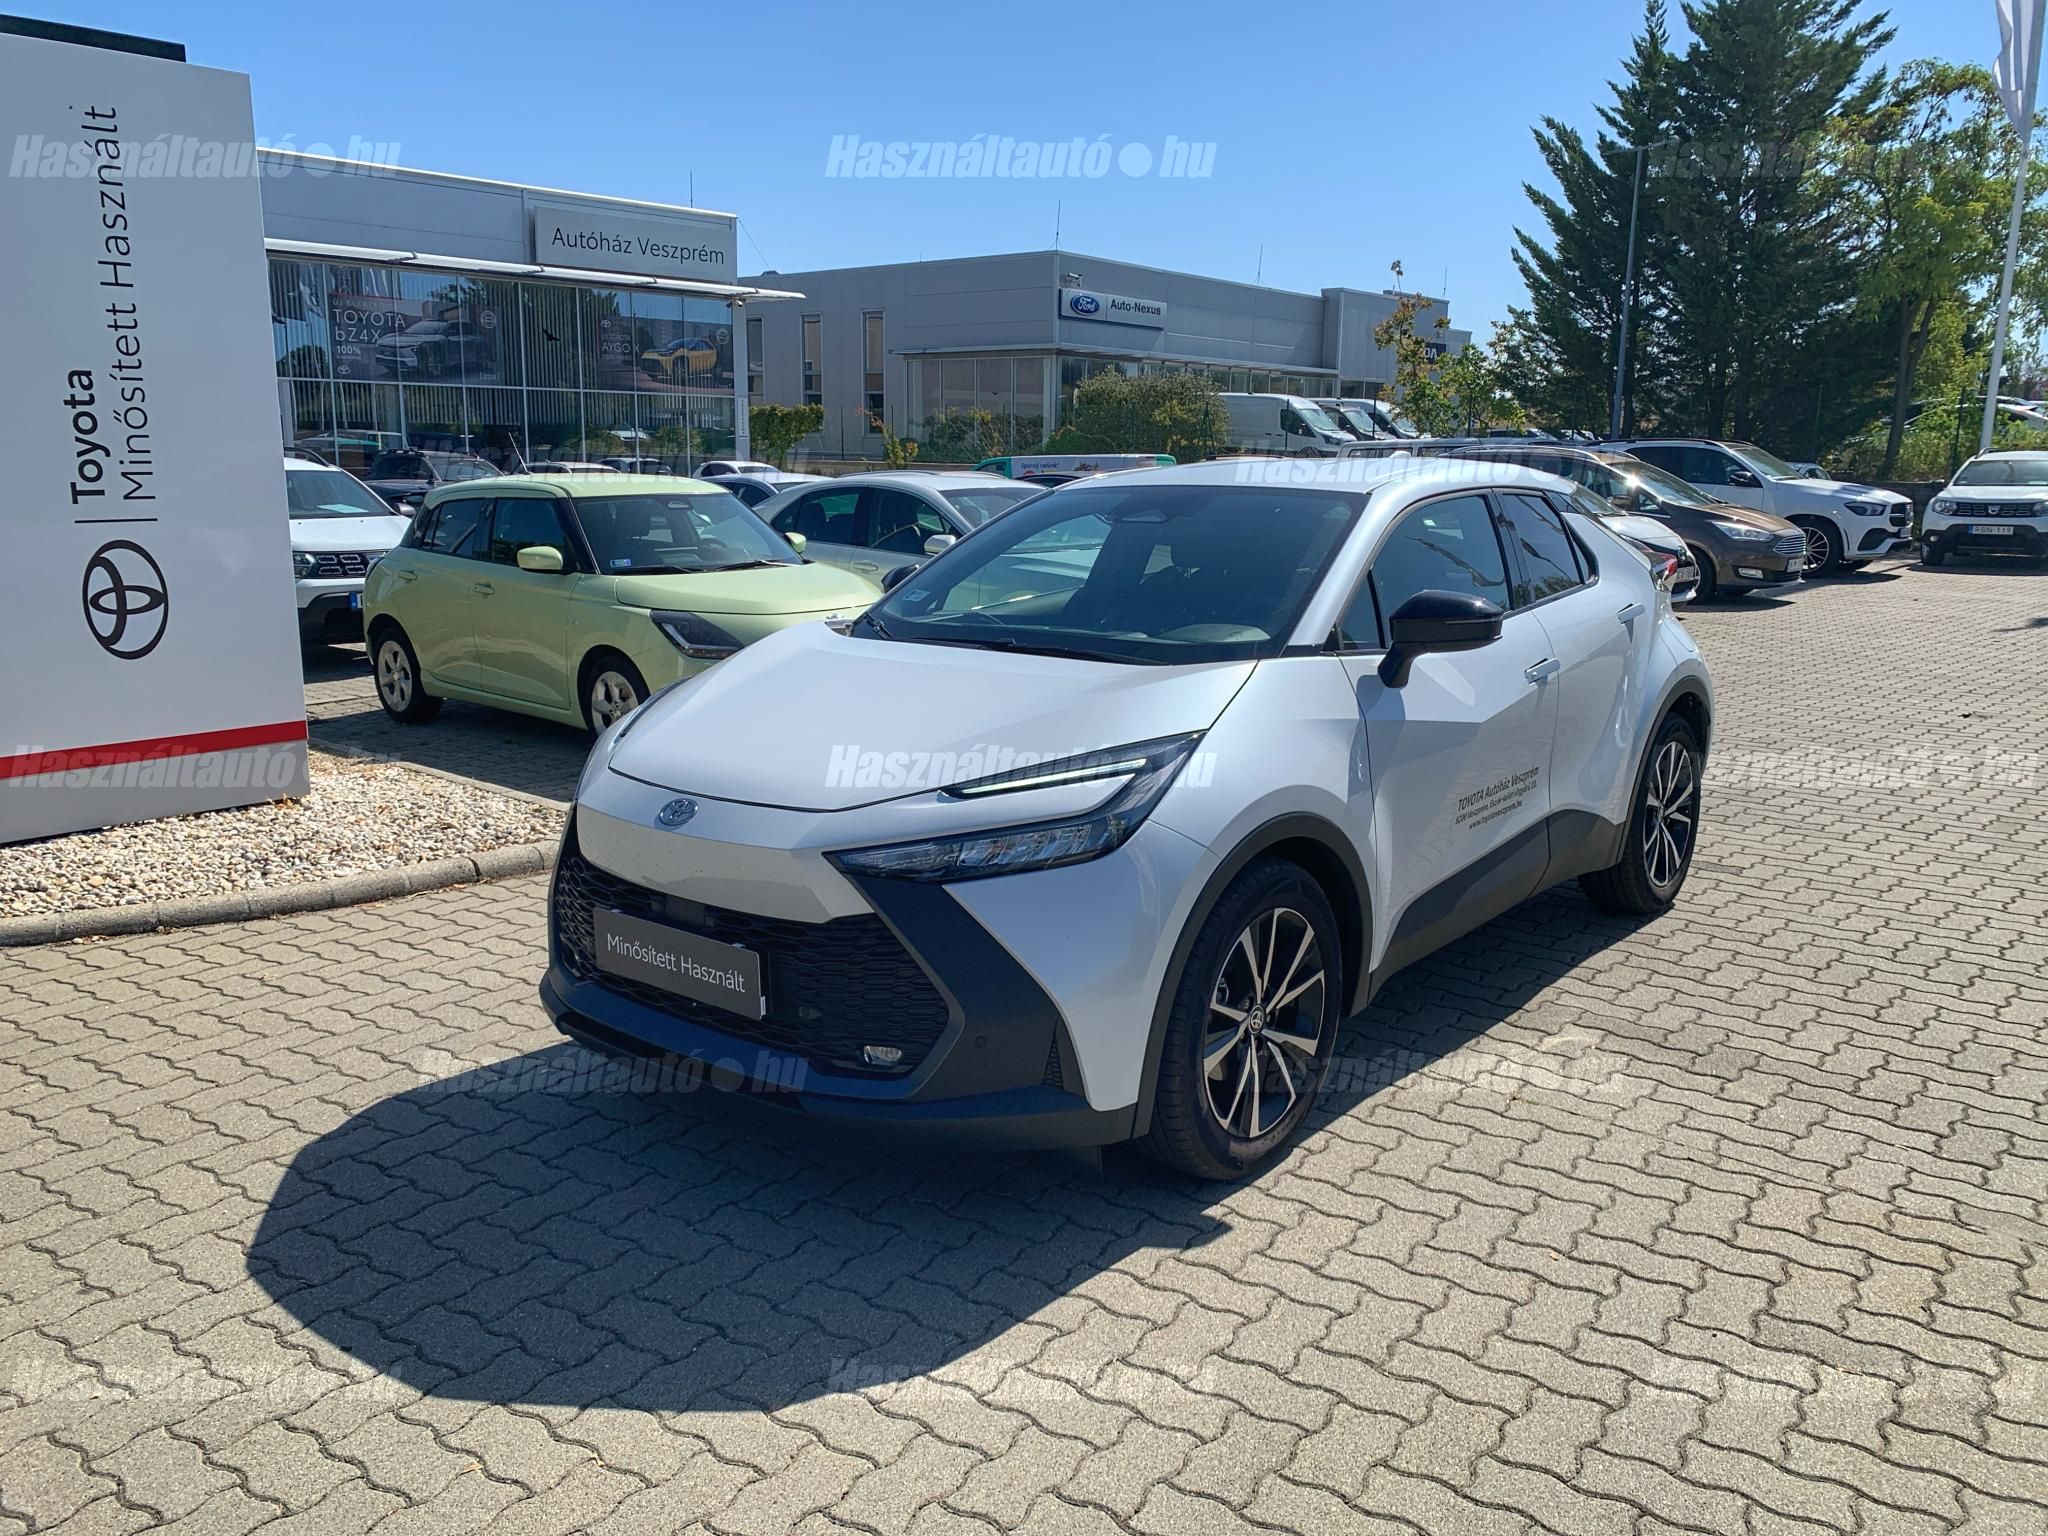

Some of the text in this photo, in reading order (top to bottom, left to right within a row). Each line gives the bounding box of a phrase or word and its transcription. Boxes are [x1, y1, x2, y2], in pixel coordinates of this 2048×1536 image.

[552, 227, 724, 265] Autóház Veszprém
[80, 105, 156, 500] Minősített Használt
[1110, 298, 1161, 316] Auto-Nexus
[332, 308, 406, 328] TOYOTA
[335, 326, 381, 343] bZ4X
[601, 341, 631, 353] AYGO
[337, 345, 361, 355] 100%
[63, 368, 111, 504] Toyota
[1457, 764, 1540, 812] TOYOTA Autóház Veszprém
[606, 933, 746, 993] Minősített Használt
